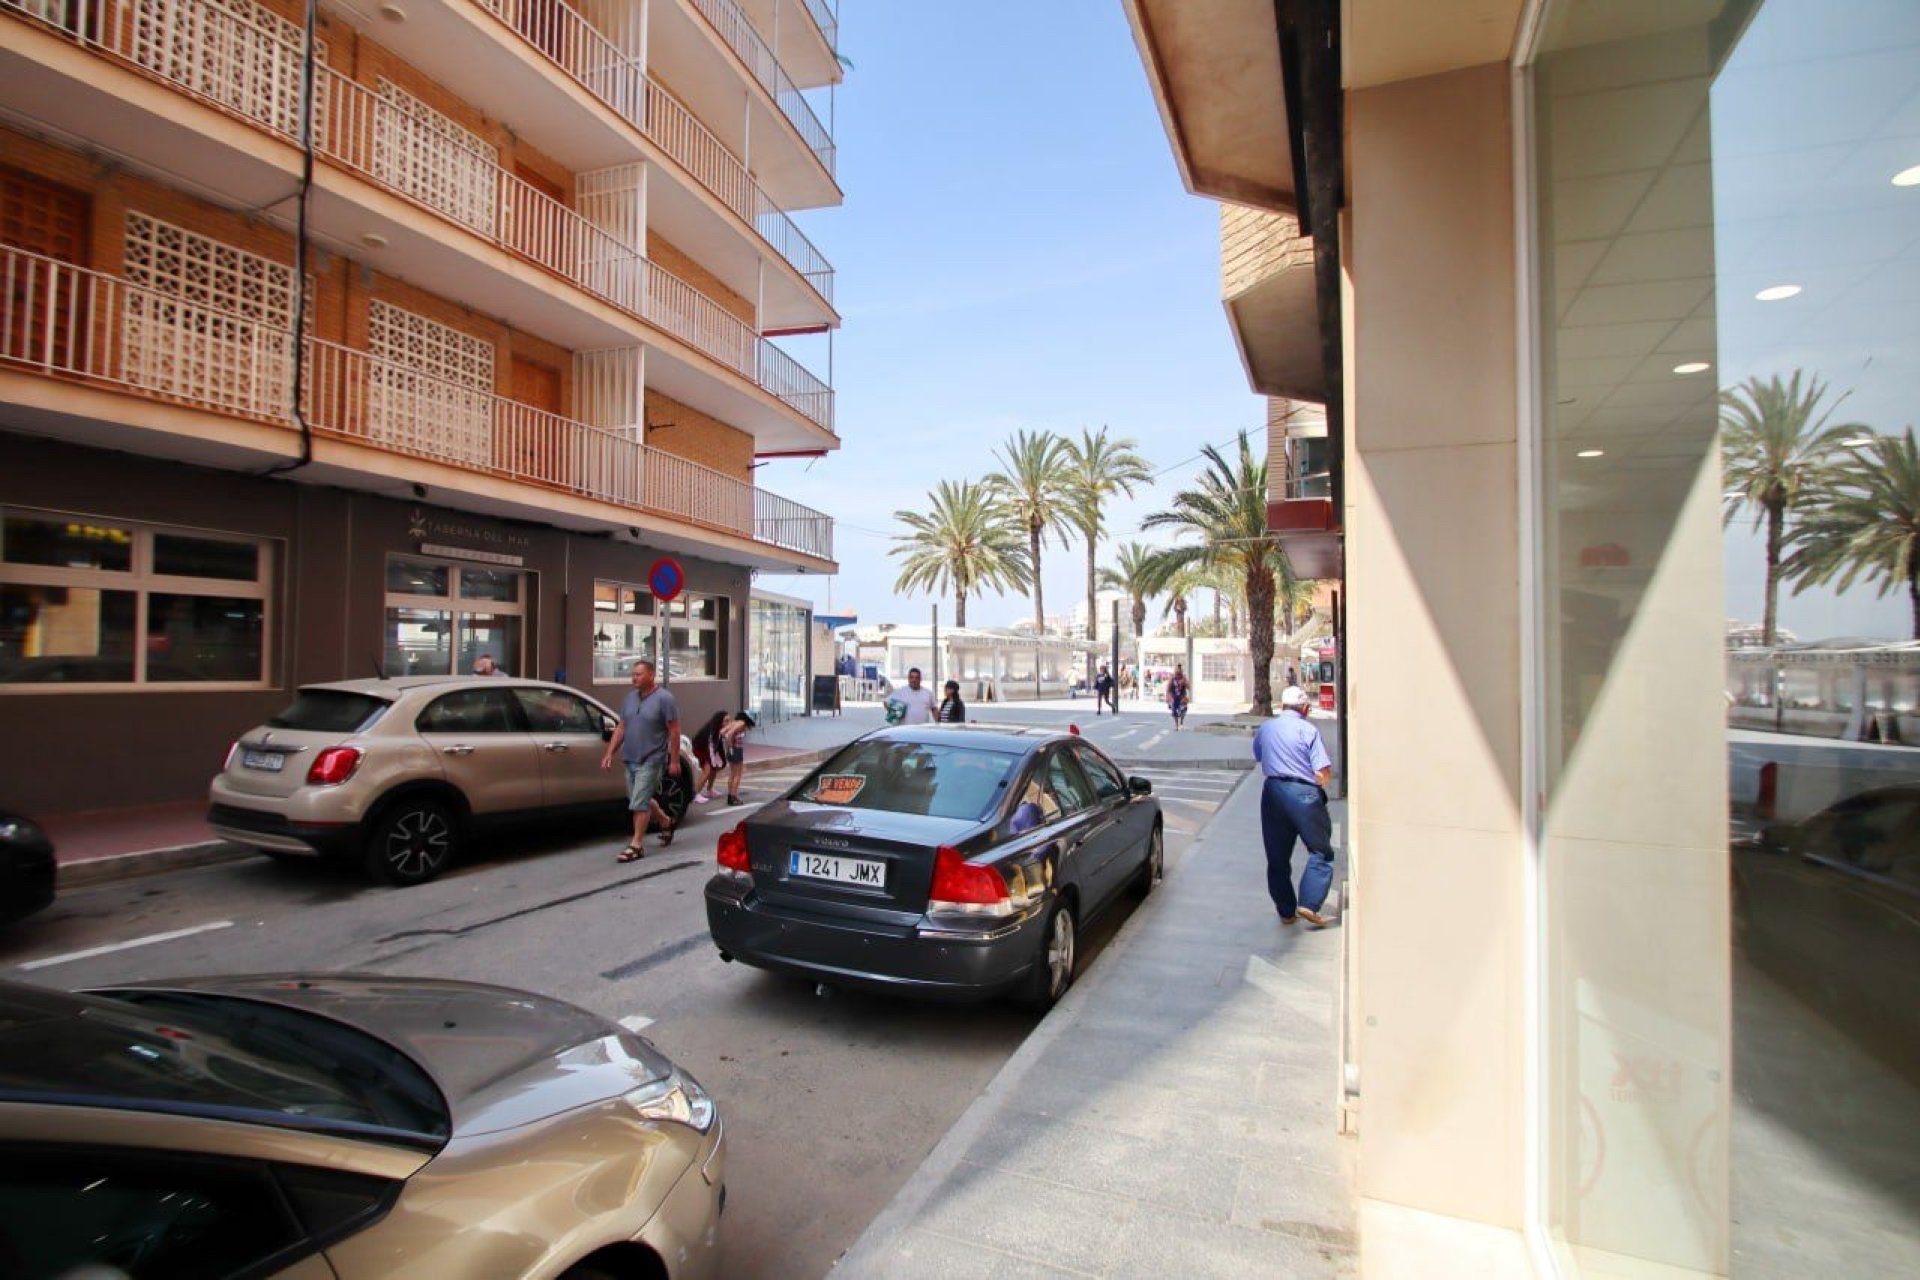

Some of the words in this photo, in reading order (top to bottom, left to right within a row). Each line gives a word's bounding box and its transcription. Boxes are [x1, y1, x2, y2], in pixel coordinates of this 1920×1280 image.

[427, 521, 480, 539] TABERNA
[484, 530, 502, 543] DEL
[508, 535, 529, 547] MAR
[805, 856, 839, 878] 1241
[849, 863, 880, 884] JMX
